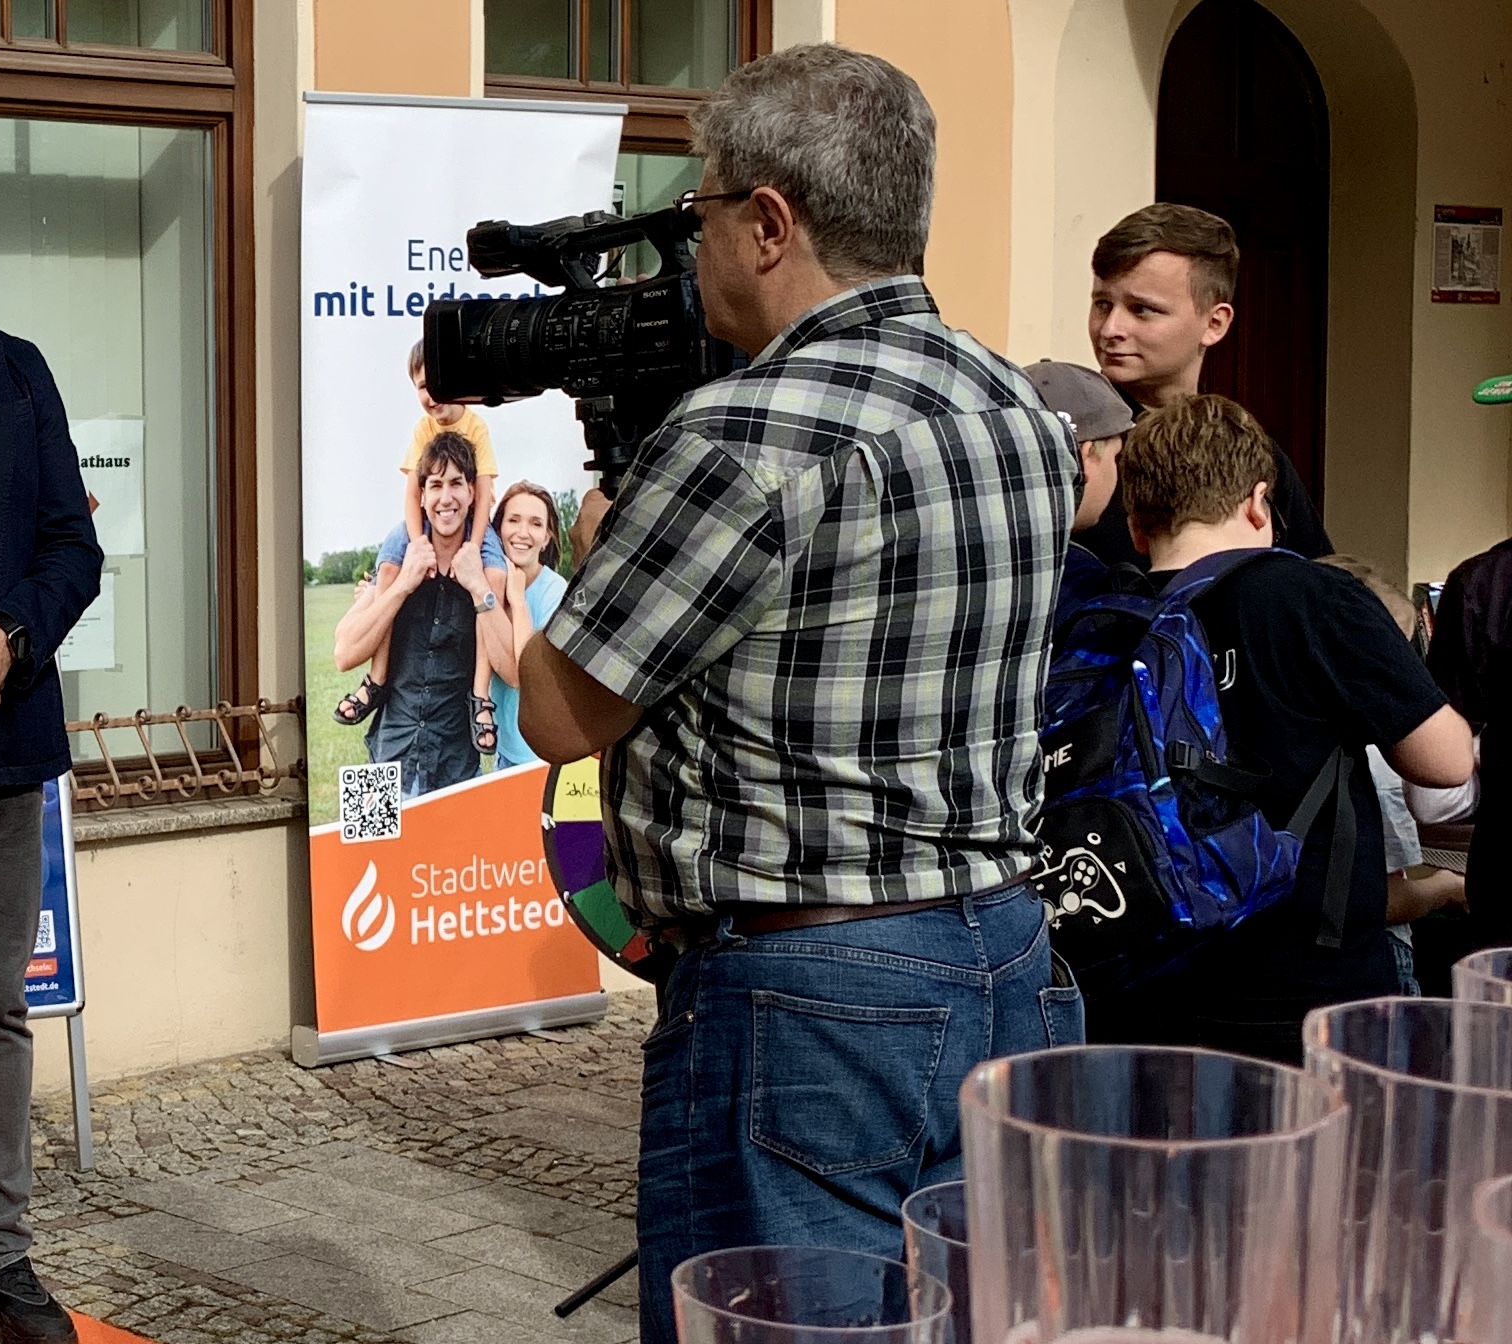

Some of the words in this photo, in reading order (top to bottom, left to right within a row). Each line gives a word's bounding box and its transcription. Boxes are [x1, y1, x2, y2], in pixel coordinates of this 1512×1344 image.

[407, 239, 472, 272] Ene
[314, 281, 375, 317] mit
[642, 288, 668, 298] SONY
[410, 896, 576, 945] Hettsted
